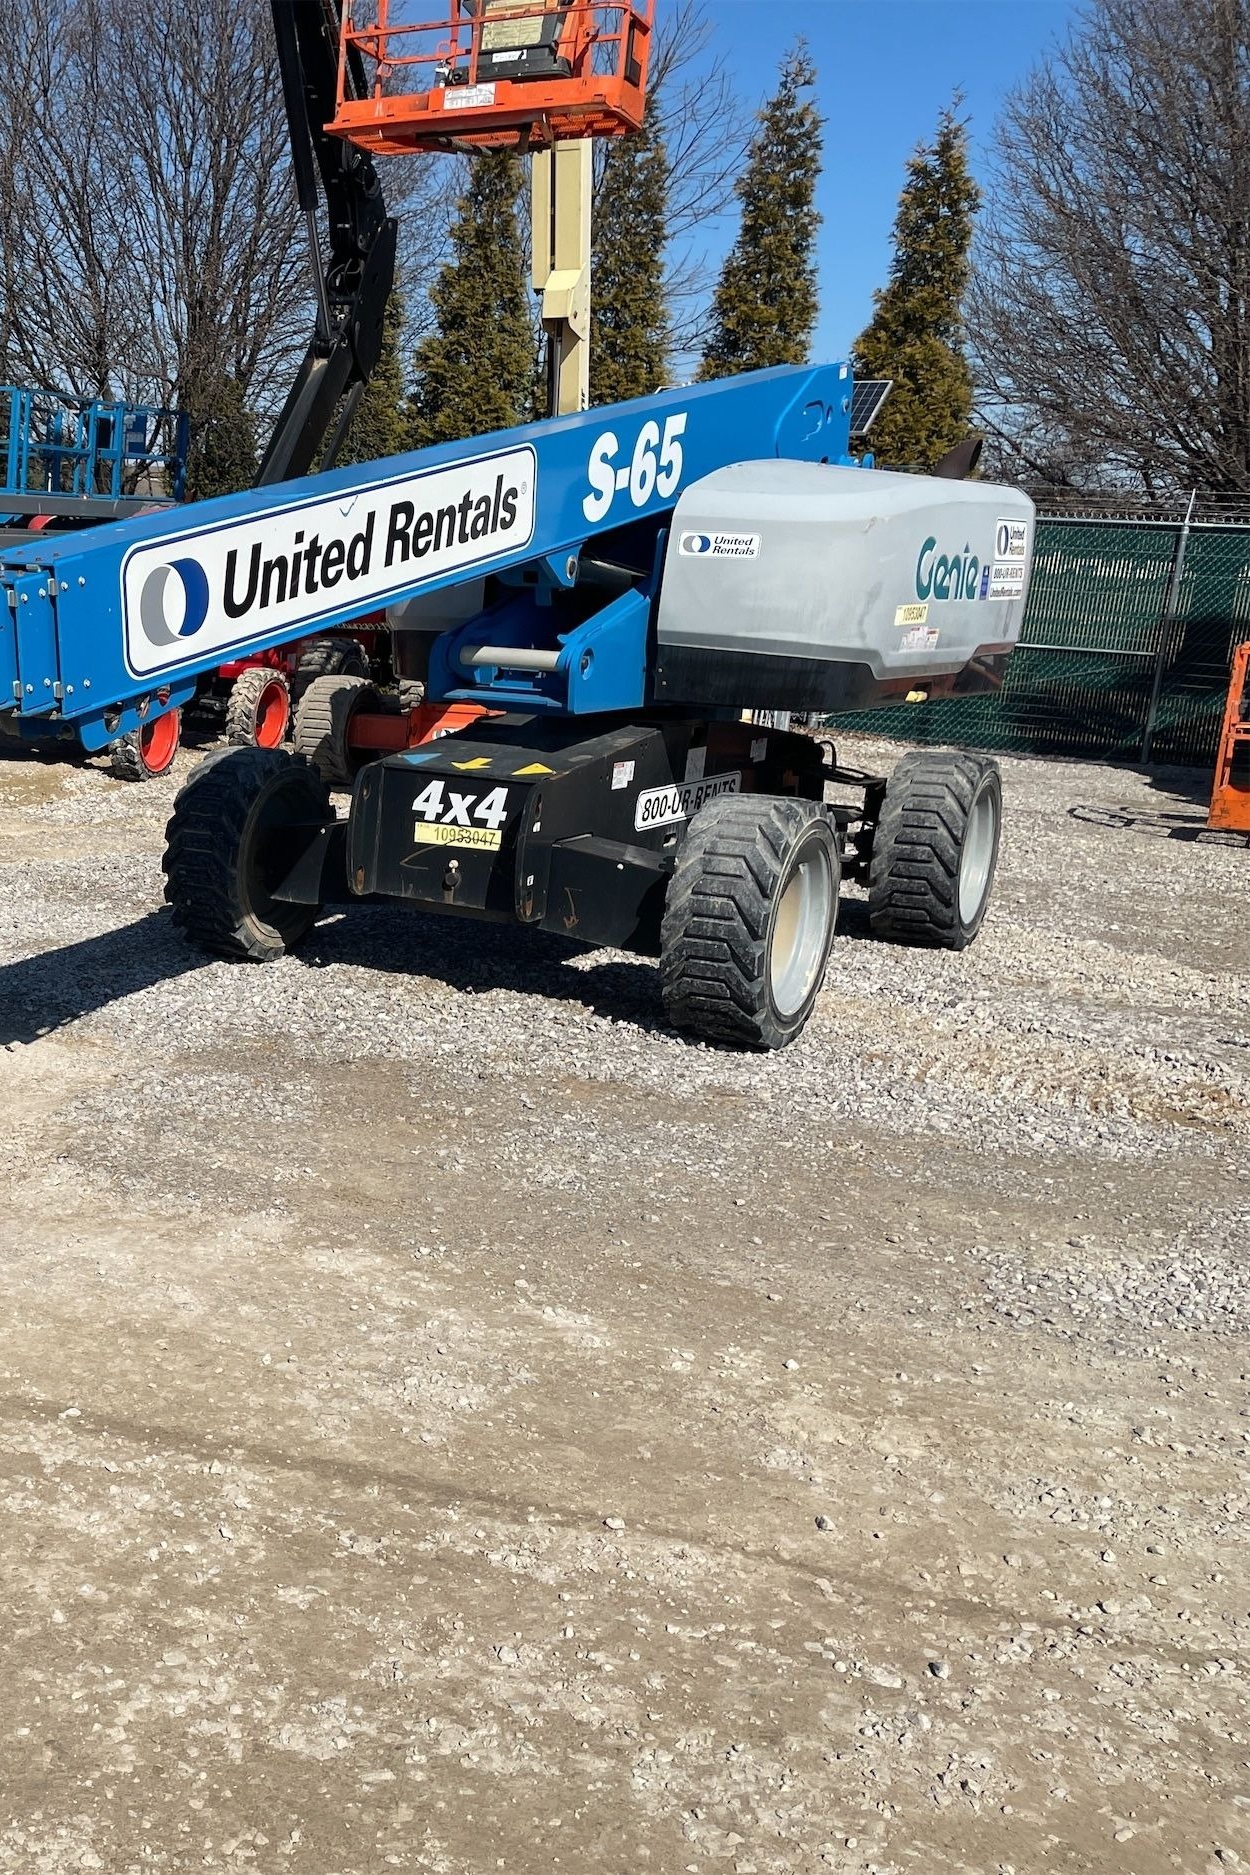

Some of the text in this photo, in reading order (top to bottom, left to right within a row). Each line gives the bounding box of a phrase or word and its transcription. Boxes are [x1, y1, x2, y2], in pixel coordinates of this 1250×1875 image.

[582, 412, 687, 522] S-65
[222, 473, 518, 619] United Rentals
[714, 536, 754, 546] United
[1010, 526, 1025, 540] United
[712, 546, 755, 556] Rentals
[916, 536, 980, 600] Genie
[412, 780, 509, 829] 4x4
[434, 827, 496, 846] 10953047
